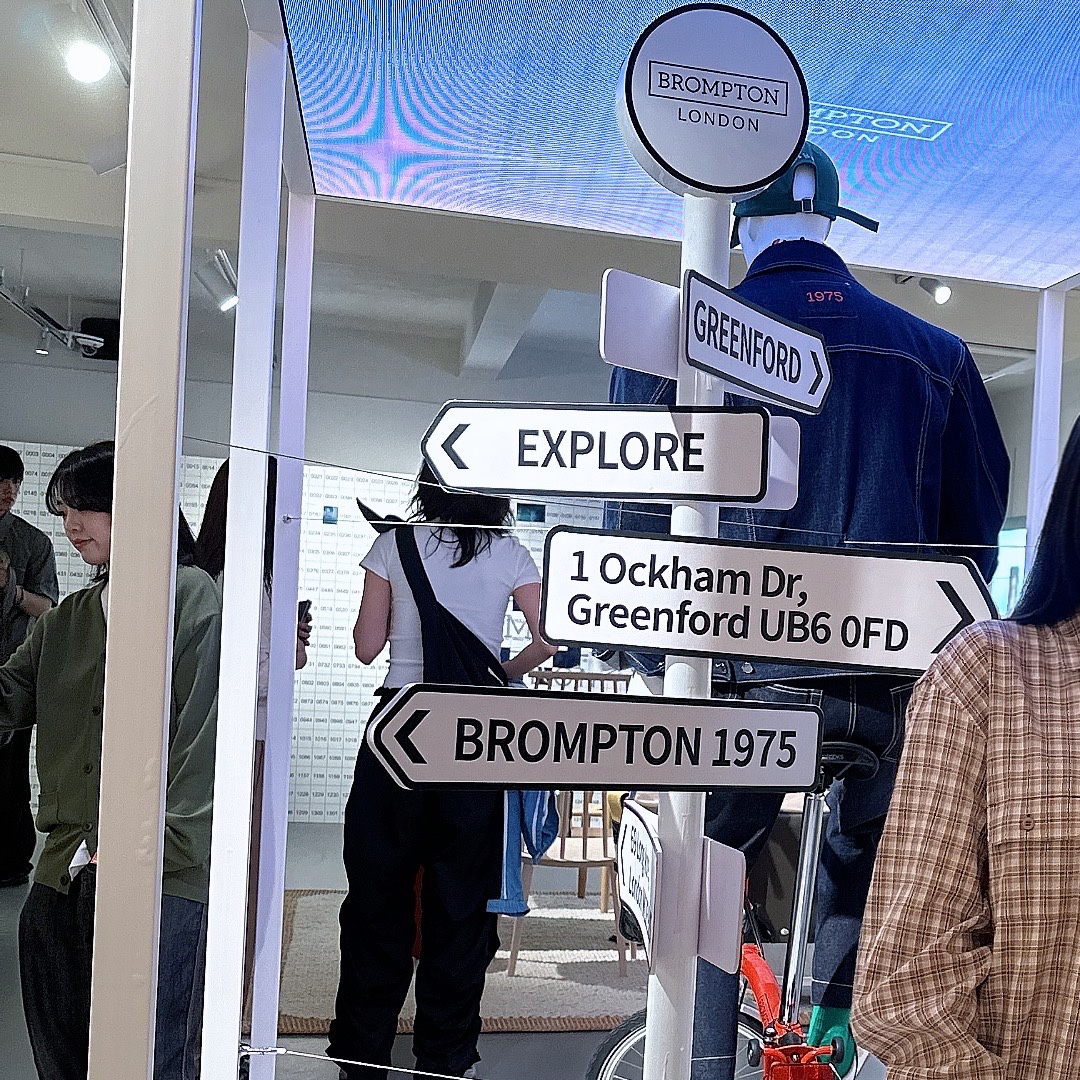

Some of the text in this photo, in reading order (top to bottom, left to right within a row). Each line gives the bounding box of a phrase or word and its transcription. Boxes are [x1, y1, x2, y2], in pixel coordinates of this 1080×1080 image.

[657, 71, 780, 107] BROMPTON
[677, 107, 760, 133] LONDON
[806, 291, 844, 303] 1975
[693, 299, 801, 385] GREENFORD
[517, 428, 705, 472] EXPLORE
[570, 550, 809, 608] 1 Ockham Dr,
[567, 593, 749, 640] Greenford
[760, 609, 832, 645] UB6
[840, 617, 909, 652] 0FD
[454, 716, 797, 768] BROMPTON 1975
